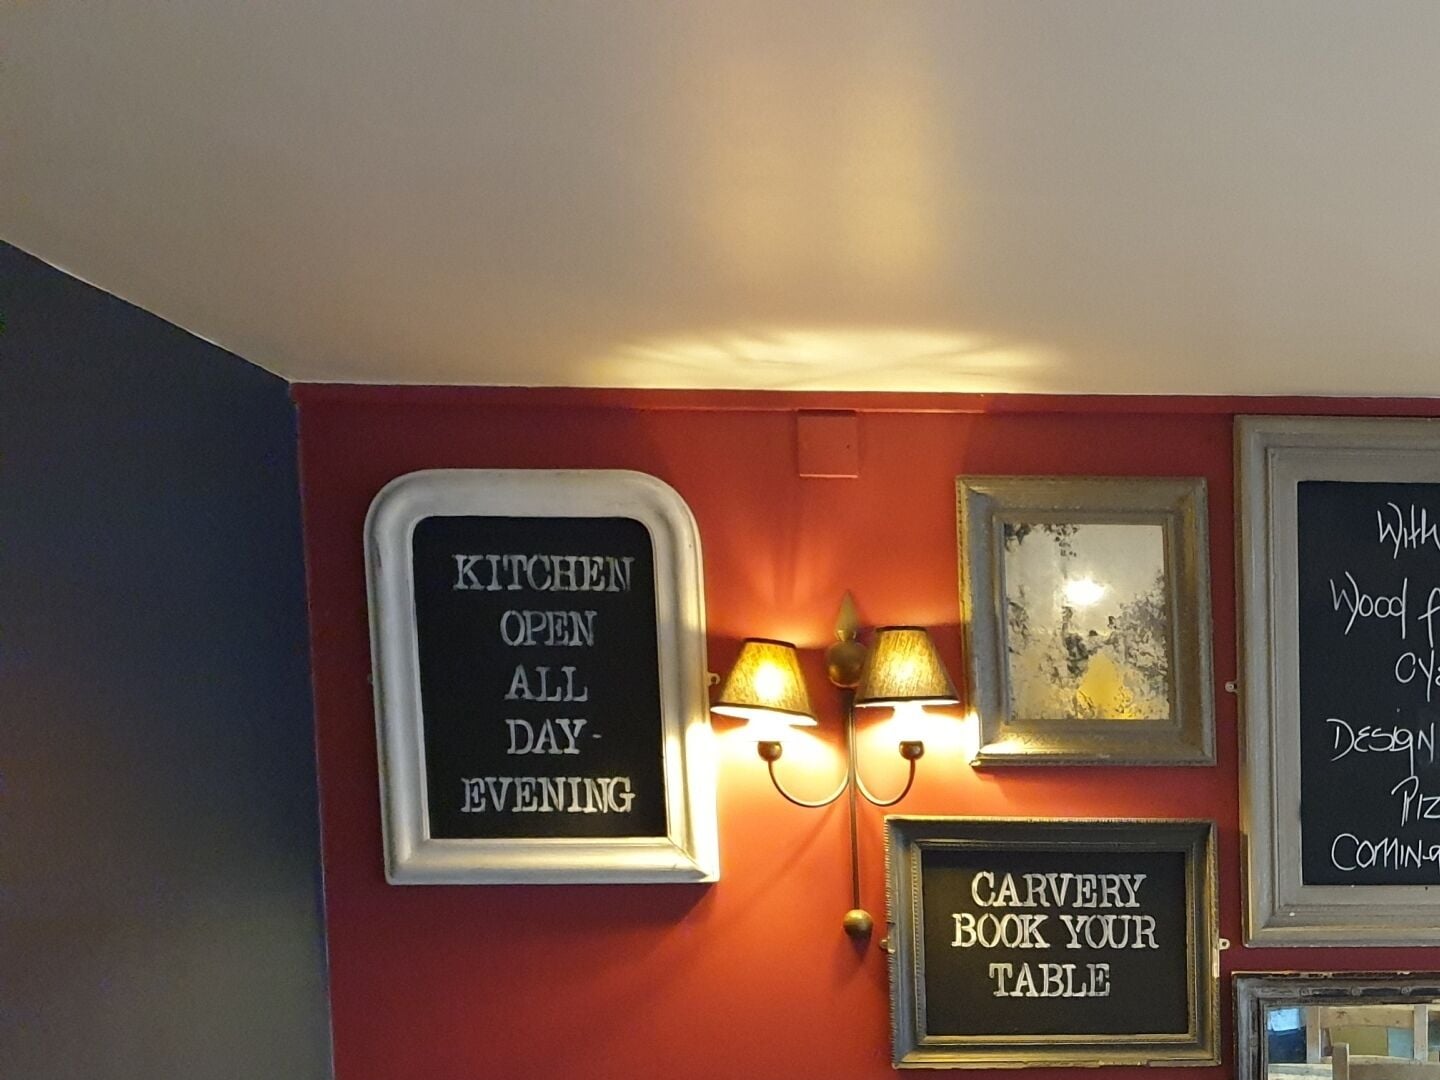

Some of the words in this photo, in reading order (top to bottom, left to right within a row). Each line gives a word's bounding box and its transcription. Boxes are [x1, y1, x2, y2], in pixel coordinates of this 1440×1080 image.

[451, 553, 634, 592] KITCHEN
[500, 610, 598, 647] OPEN
[504, 664, 589, 702] ALL
[460, 776, 636, 813] EVENING
[971, 871, 1147, 908] CARVERY
[951, 913, 1050, 949] BOOK
[1059, 914, 1160, 949] YOUR
[988, 963, 1111, 997] TABLE
